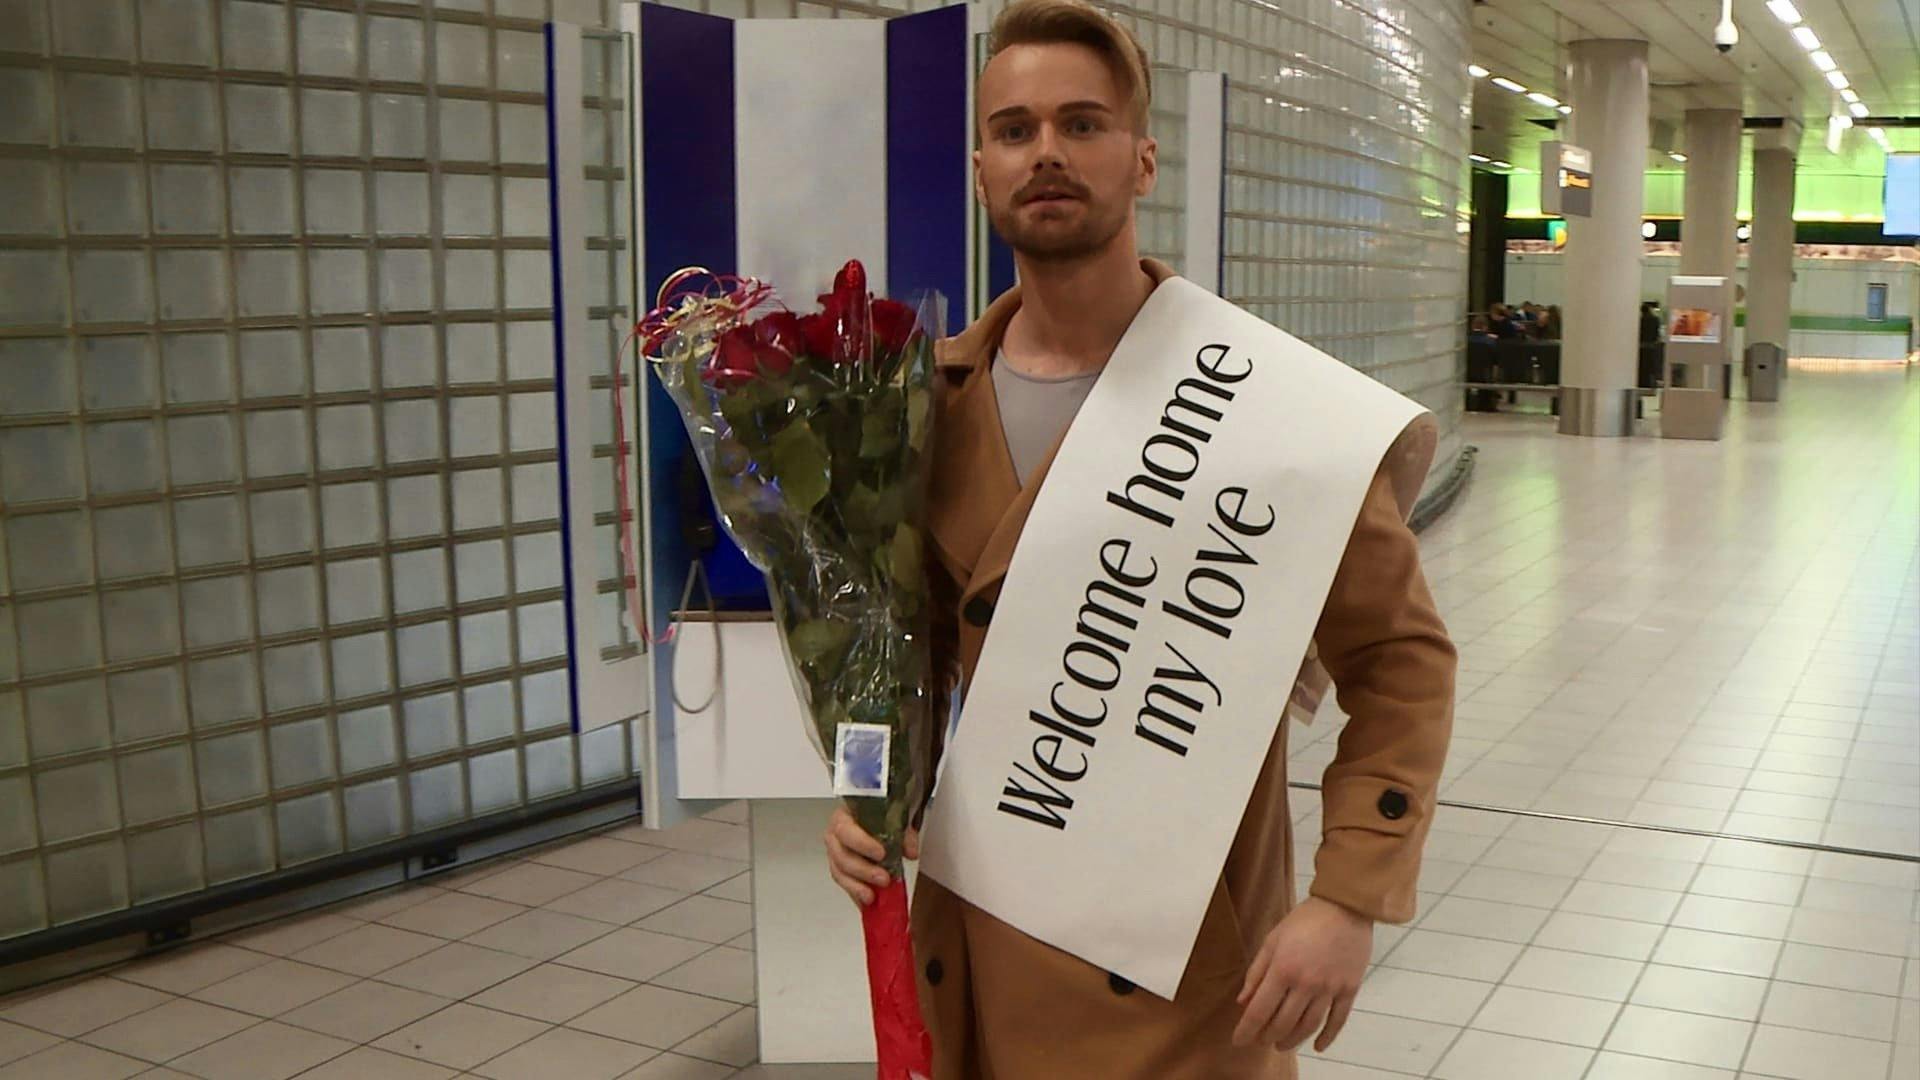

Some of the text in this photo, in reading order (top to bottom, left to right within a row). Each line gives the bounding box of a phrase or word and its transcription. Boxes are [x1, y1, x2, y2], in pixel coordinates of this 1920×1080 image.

[996, 343, 1253, 831] Welcome home
[1134, 486, 1276, 757] my love
